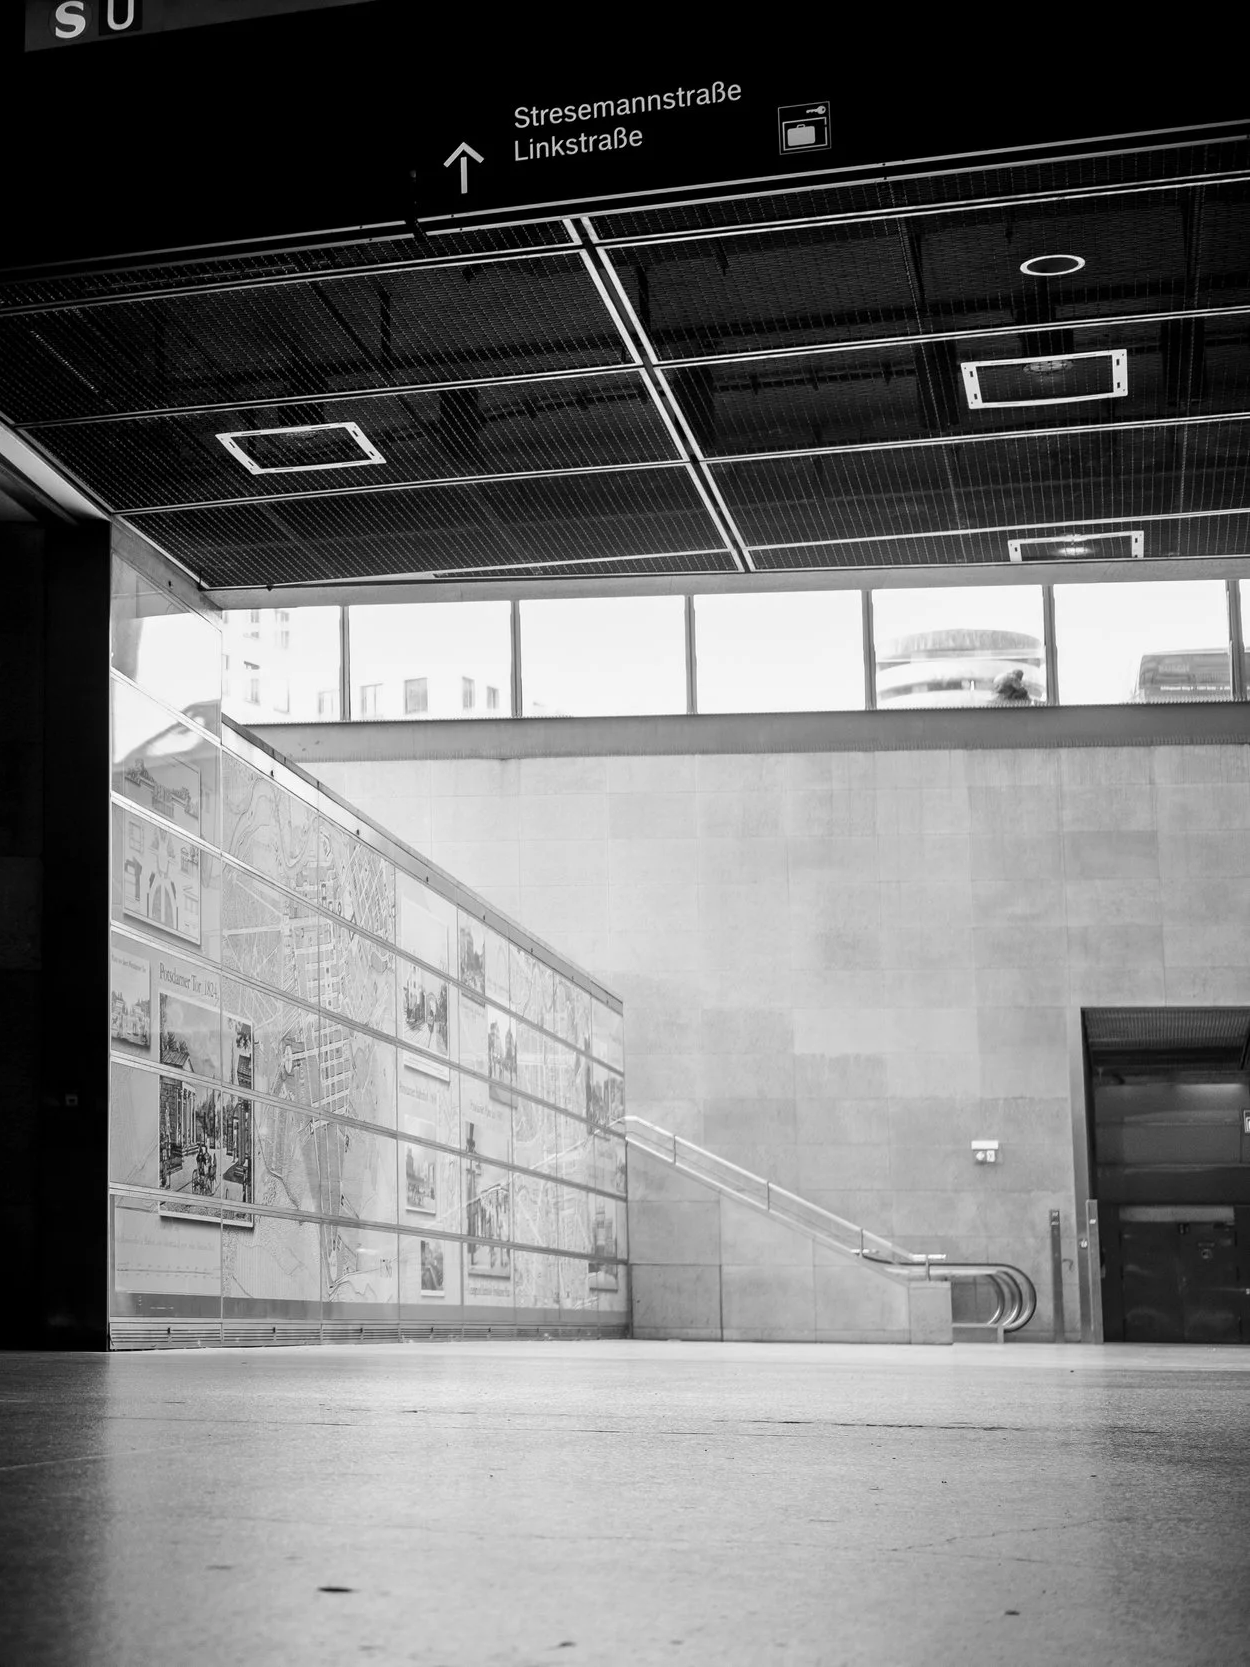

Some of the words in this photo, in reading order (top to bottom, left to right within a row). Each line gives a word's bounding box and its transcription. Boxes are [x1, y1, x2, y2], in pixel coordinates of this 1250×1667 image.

[55, 0, 86, 39] S
[107, 0, 135, 31] U
[514, 80, 742, 129] Stresemannstraße
[514, 126, 643, 162] Linkstraße
[159, 962, 191, 990] Potsdamer
[191, 974, 202, 994] Tor
